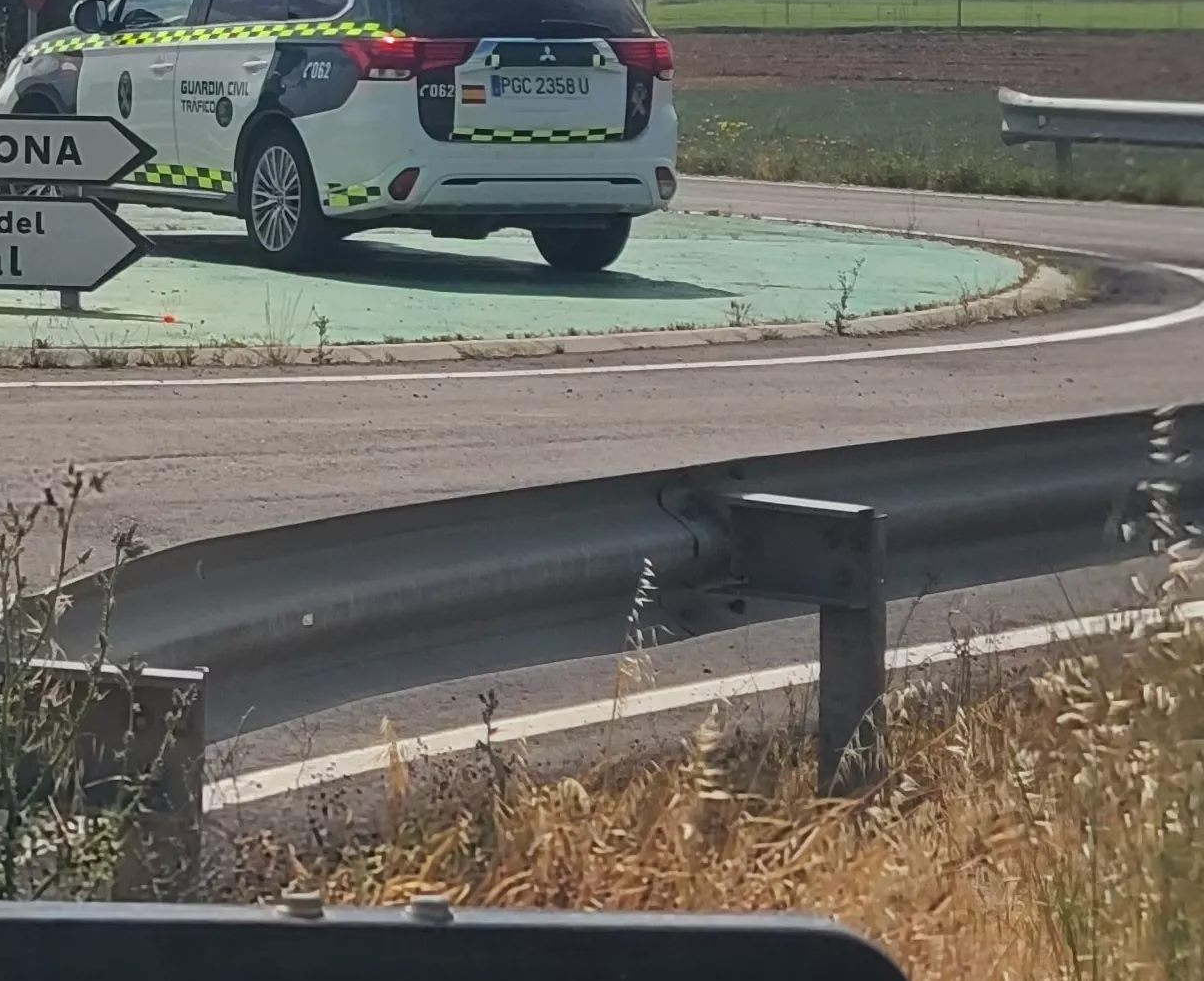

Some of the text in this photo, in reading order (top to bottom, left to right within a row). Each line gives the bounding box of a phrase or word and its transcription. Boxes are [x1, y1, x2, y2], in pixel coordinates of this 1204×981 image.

[311, 62, 331, 79] 062
[180, 80, 249, 96] GUARDIA CIVIL
[429, 84, 455, 98] 062
[501, 76, 532, 94] PGC
[536, 77, 575, 95] 2358
[578, 78, 590, 95] U
